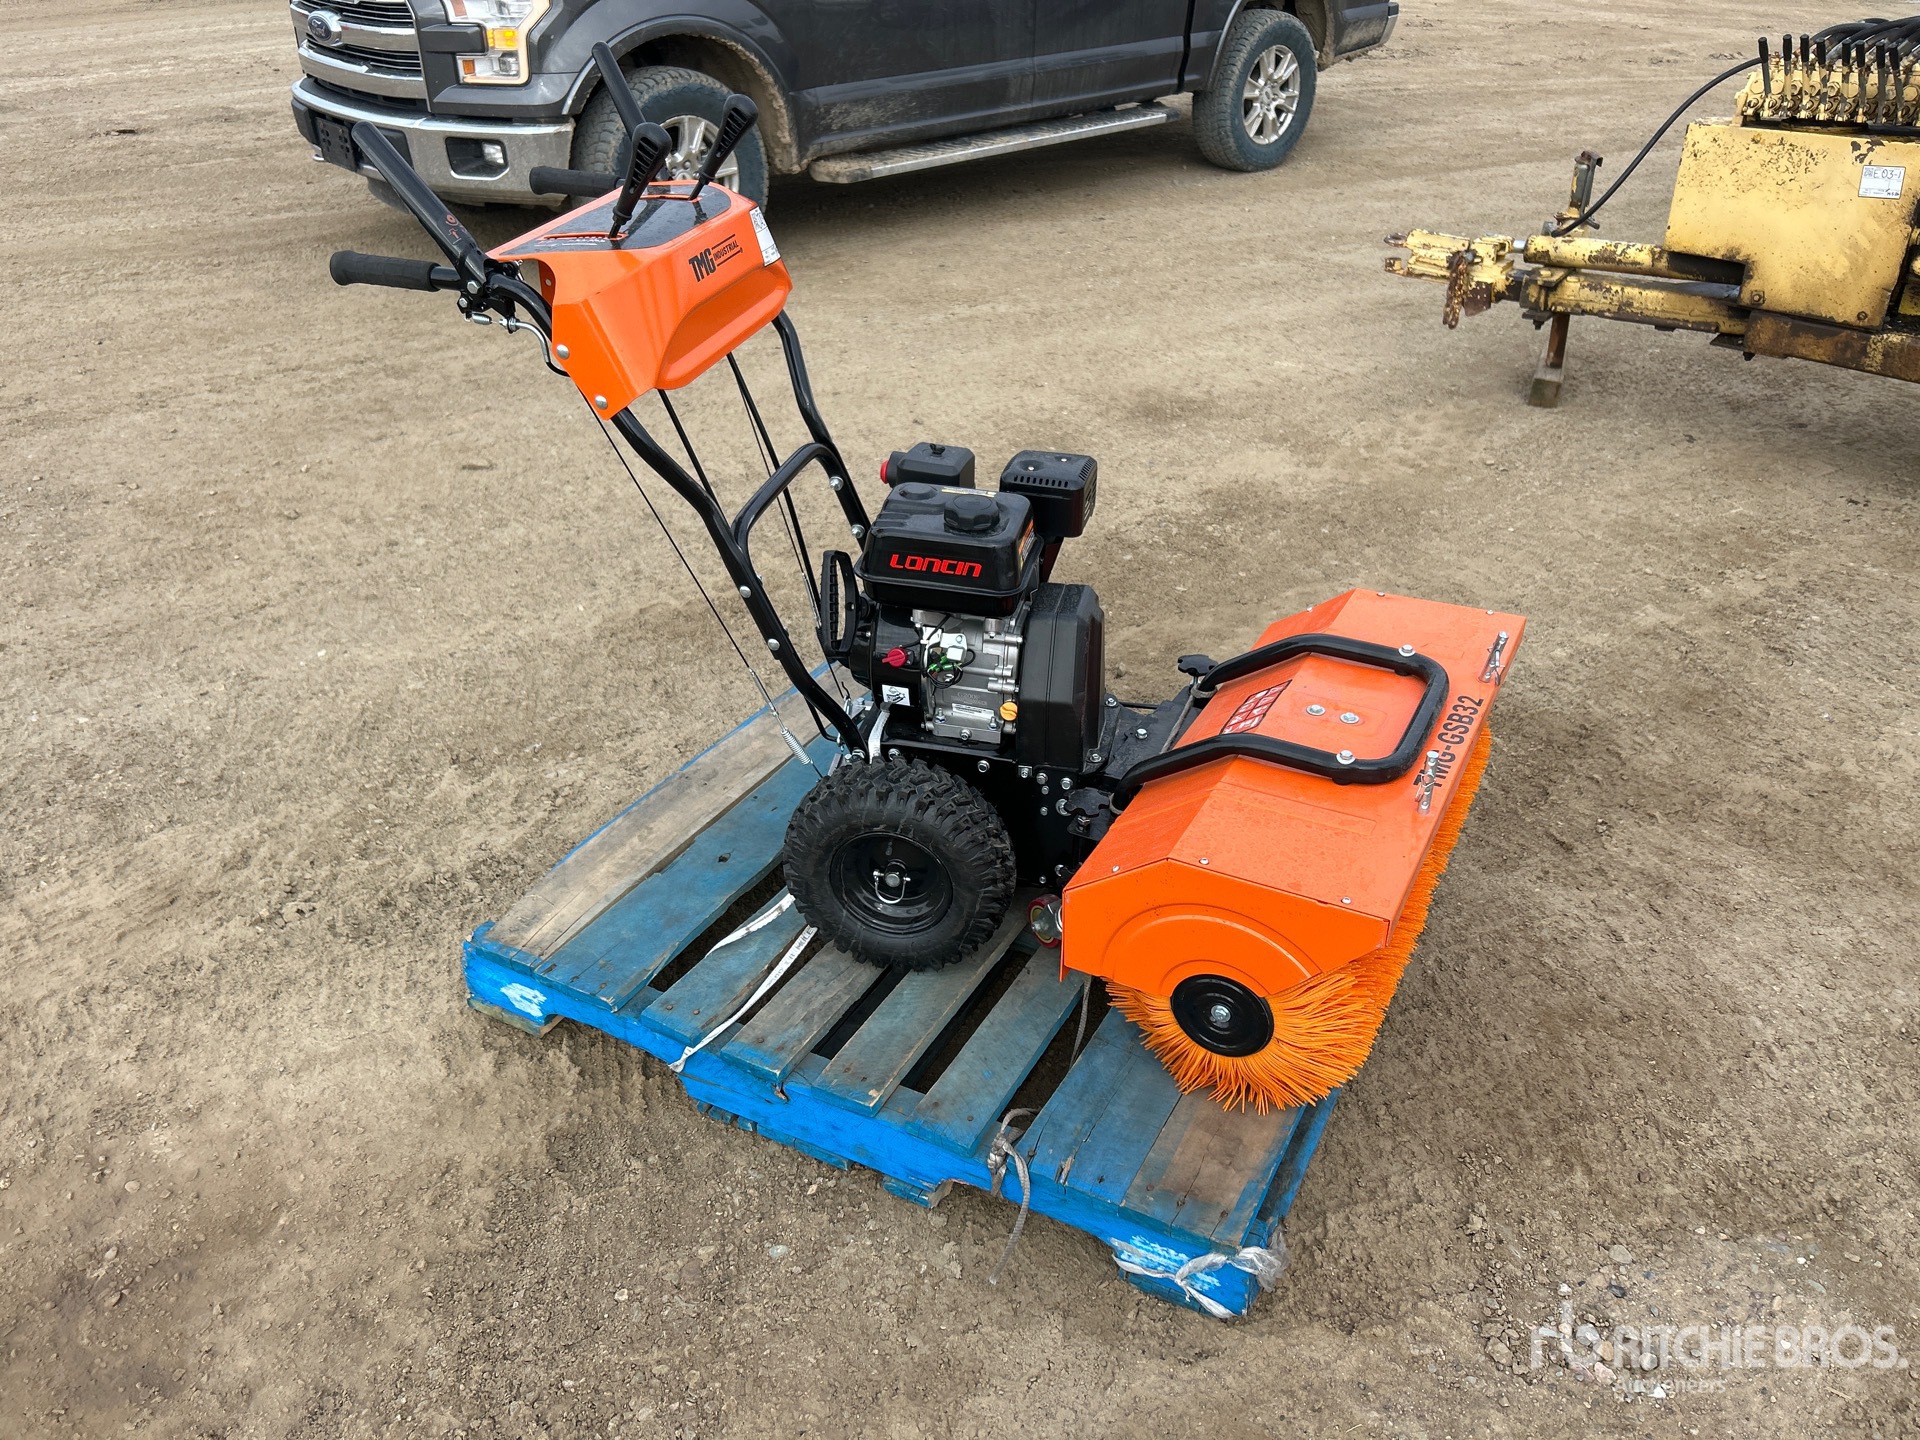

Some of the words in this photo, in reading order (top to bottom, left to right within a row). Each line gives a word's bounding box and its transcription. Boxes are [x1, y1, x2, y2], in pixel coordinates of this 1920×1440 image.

[689, 248, 717, 282] TMG
[713, 239, 739, 262] INDUSTRIAL
[1413, 695, 1484, 788] TMG-GSB32
